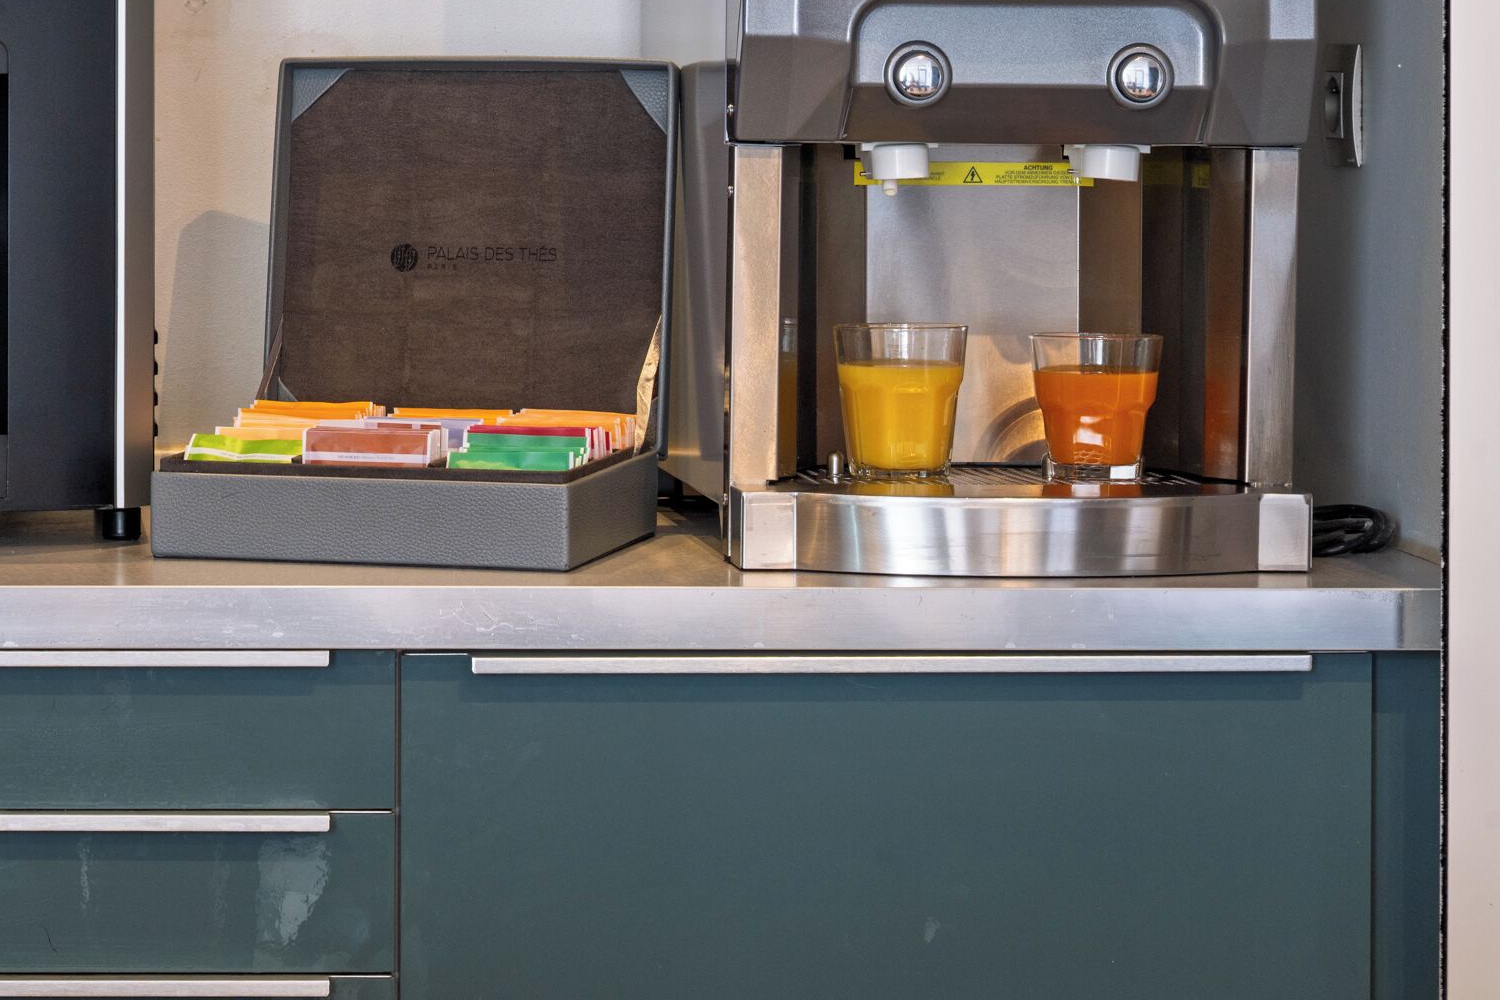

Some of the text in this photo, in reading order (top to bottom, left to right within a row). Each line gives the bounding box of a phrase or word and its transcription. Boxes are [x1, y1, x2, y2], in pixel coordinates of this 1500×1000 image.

[427, 245, 558, 262] PALAIS DES THÉS
